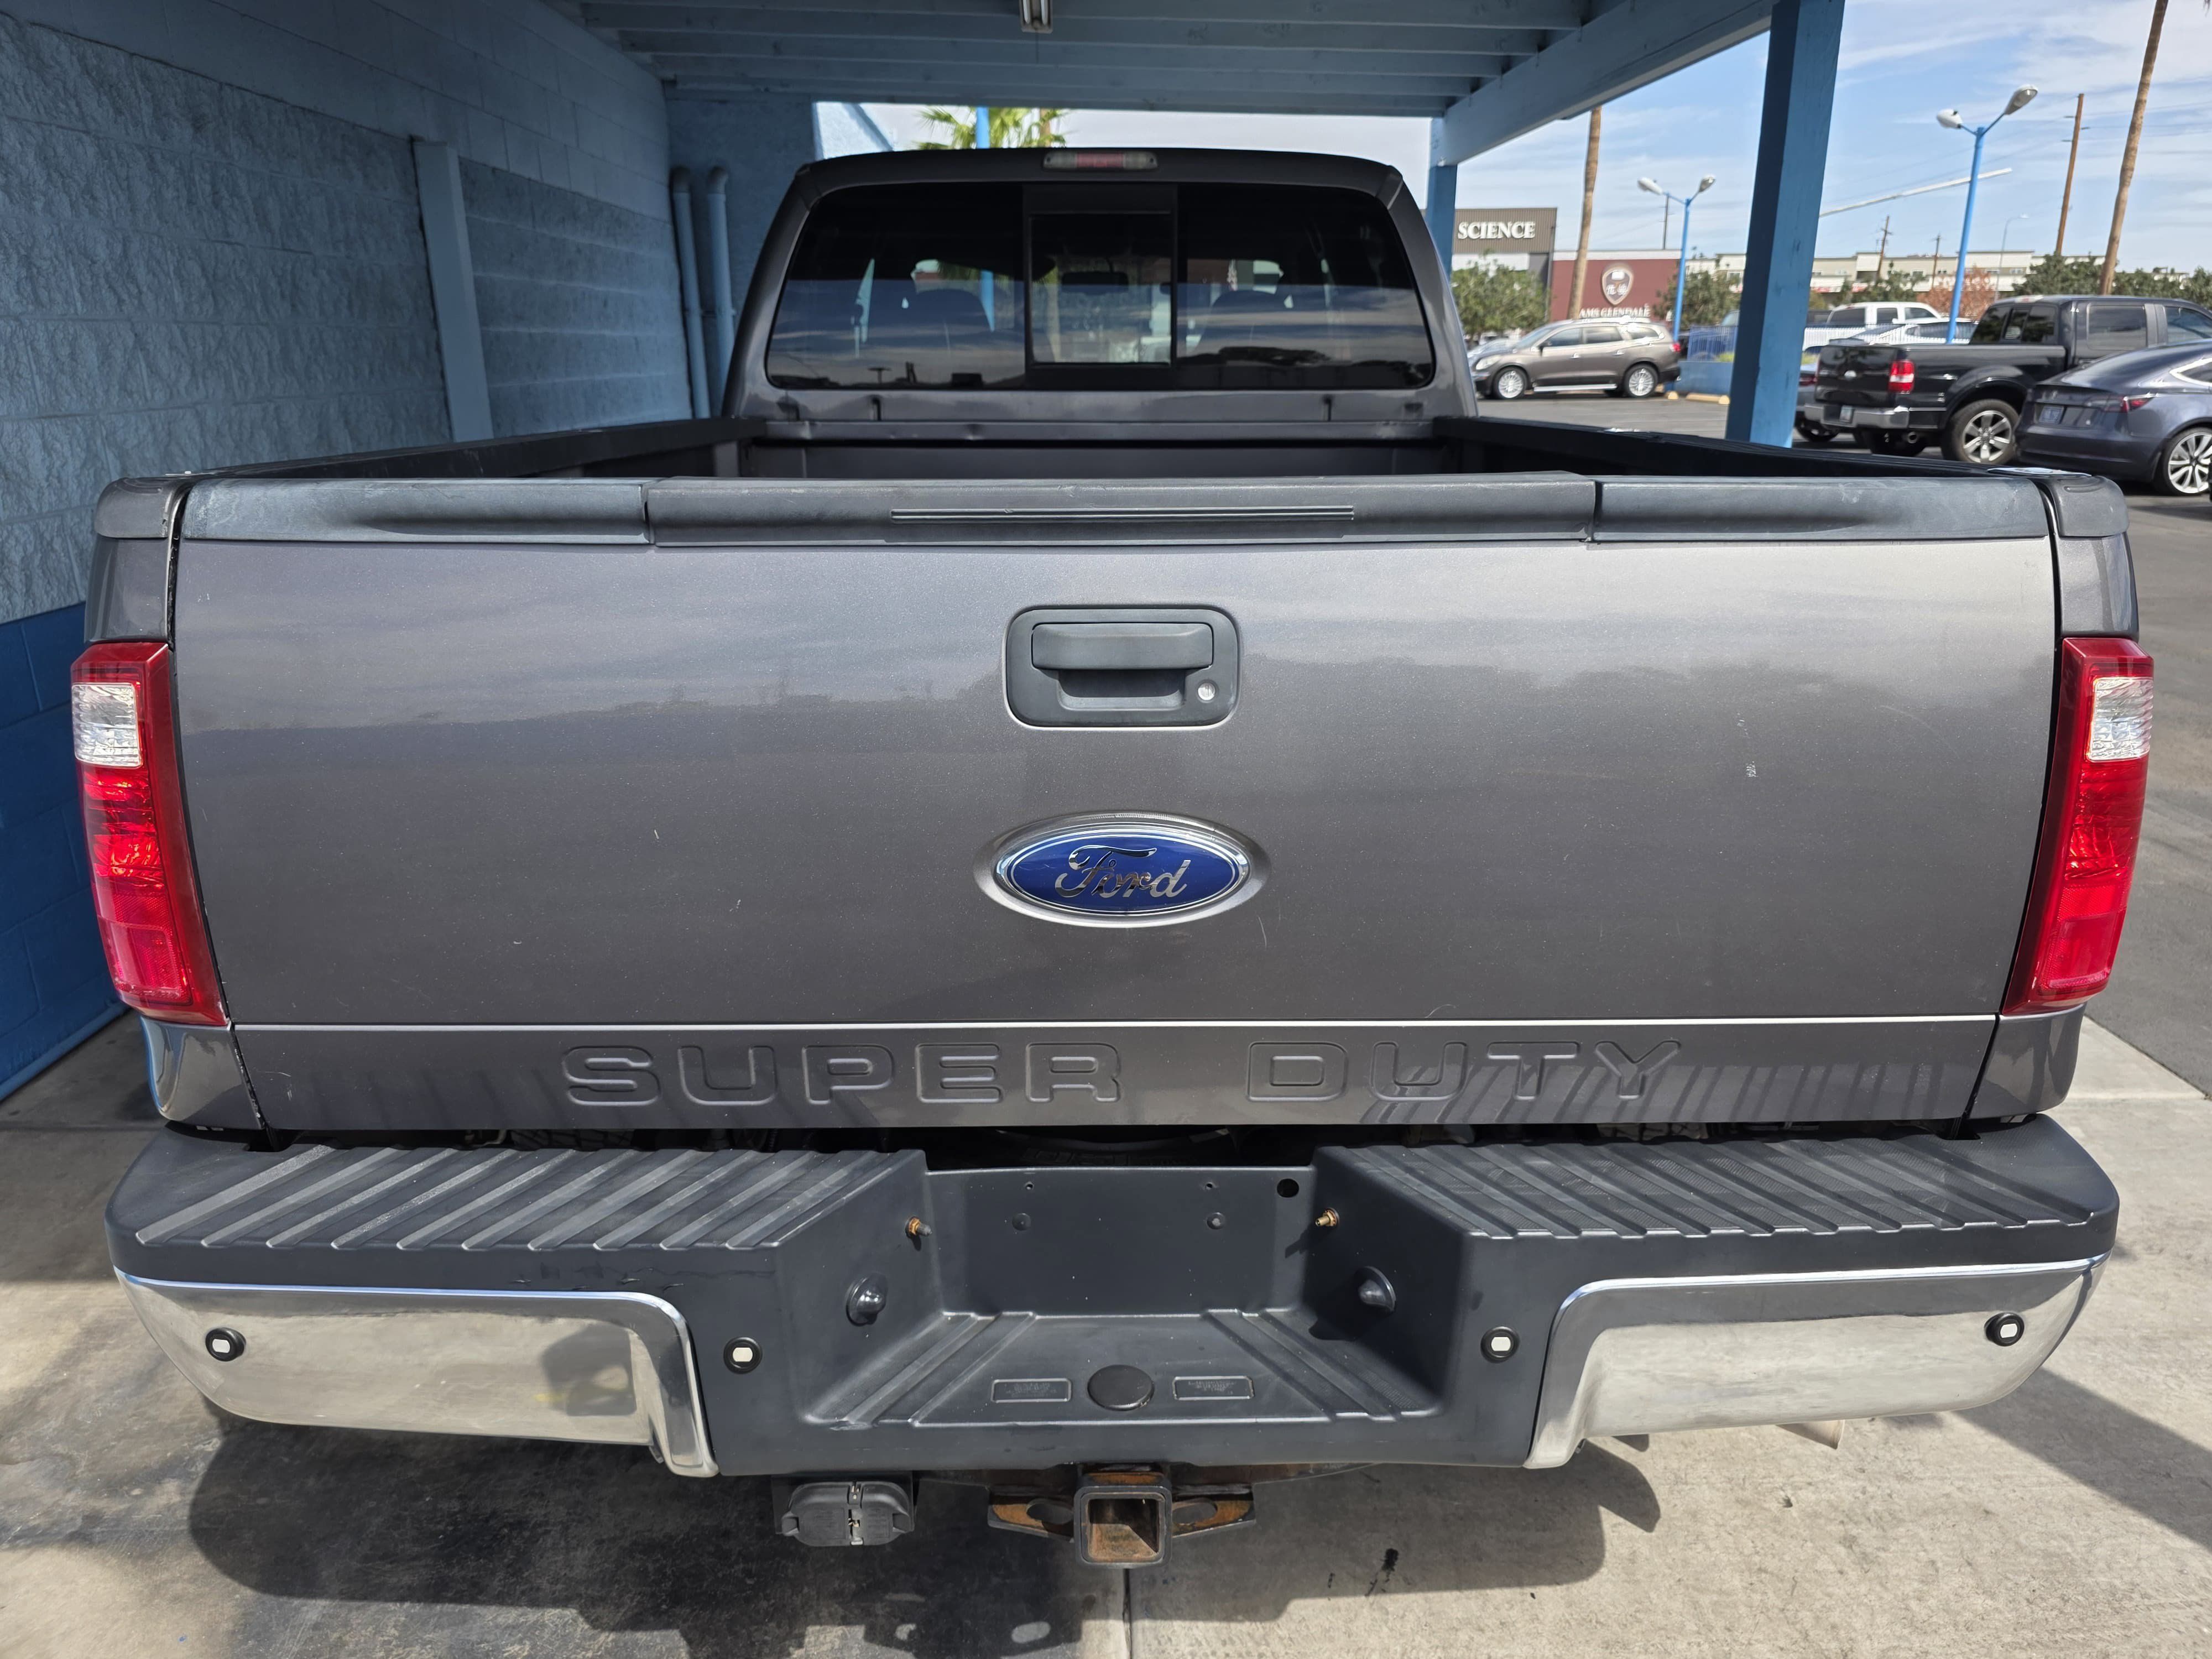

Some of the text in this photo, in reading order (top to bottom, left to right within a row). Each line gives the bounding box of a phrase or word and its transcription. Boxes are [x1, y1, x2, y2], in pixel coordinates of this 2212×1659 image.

[1457, 221, 1536, 239] SCIENCE
[1055, 844, 1191, 898] Ford
[561, 1039, 1682, 1107] SUPER DUTY
